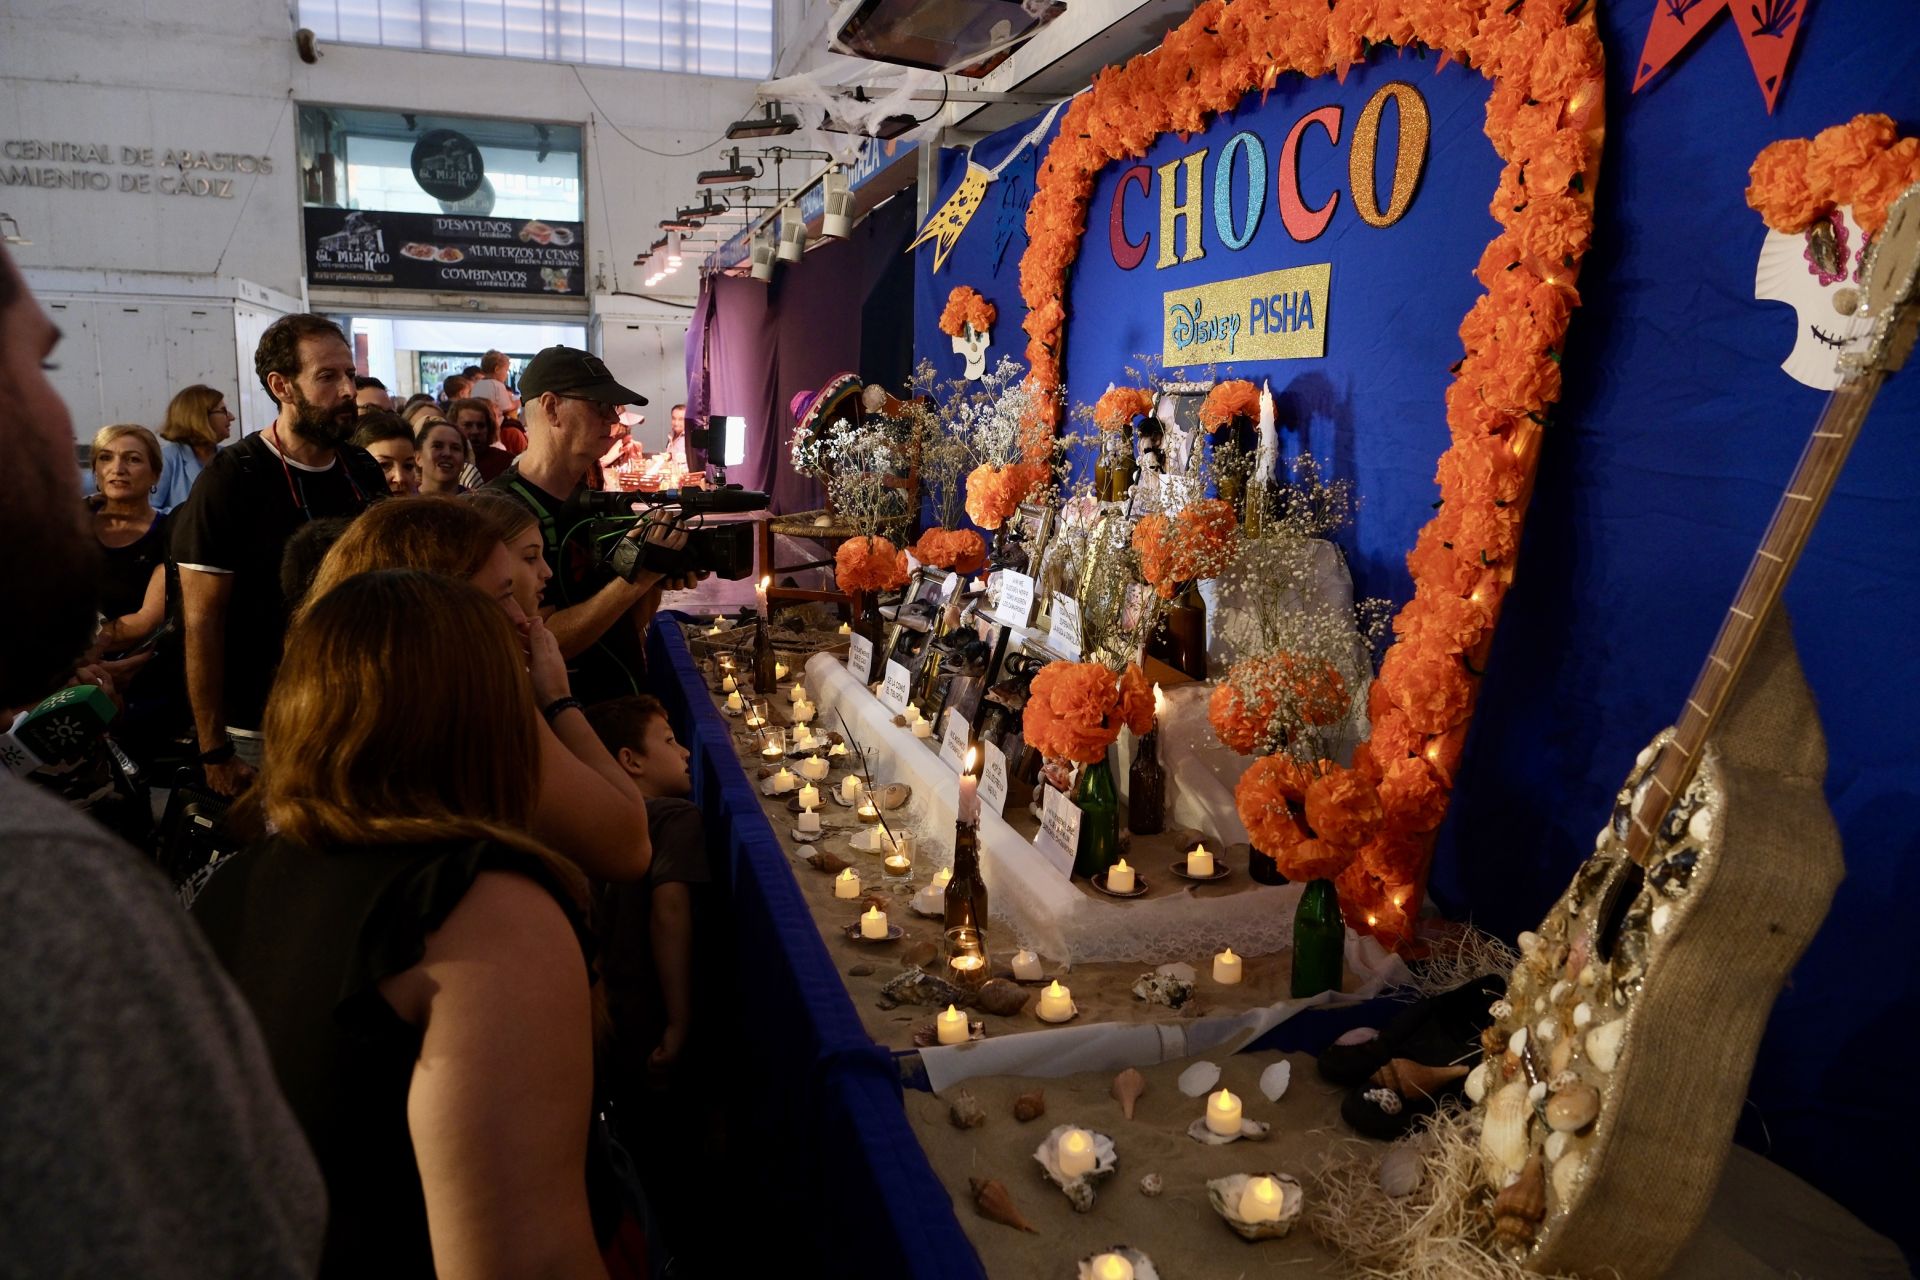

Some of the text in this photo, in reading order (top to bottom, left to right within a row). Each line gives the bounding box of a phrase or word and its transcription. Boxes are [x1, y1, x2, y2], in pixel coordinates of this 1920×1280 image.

[4, 140, 273, 175] CENTRAL DE ABASTOS
[120, 173, 151, 193] DE
[158, 171, 235, 199] CÁDIZ
[1109, 80, 1431, 271] CHOCO
[436, 218, 512, 233] DESAYUNOS
[468, 245, 580, 261] ALMUERZOS Y CENAS
[441, 268, 528, 283] COMBINADOS
[1250, 290, 1315, 336] PISHA
